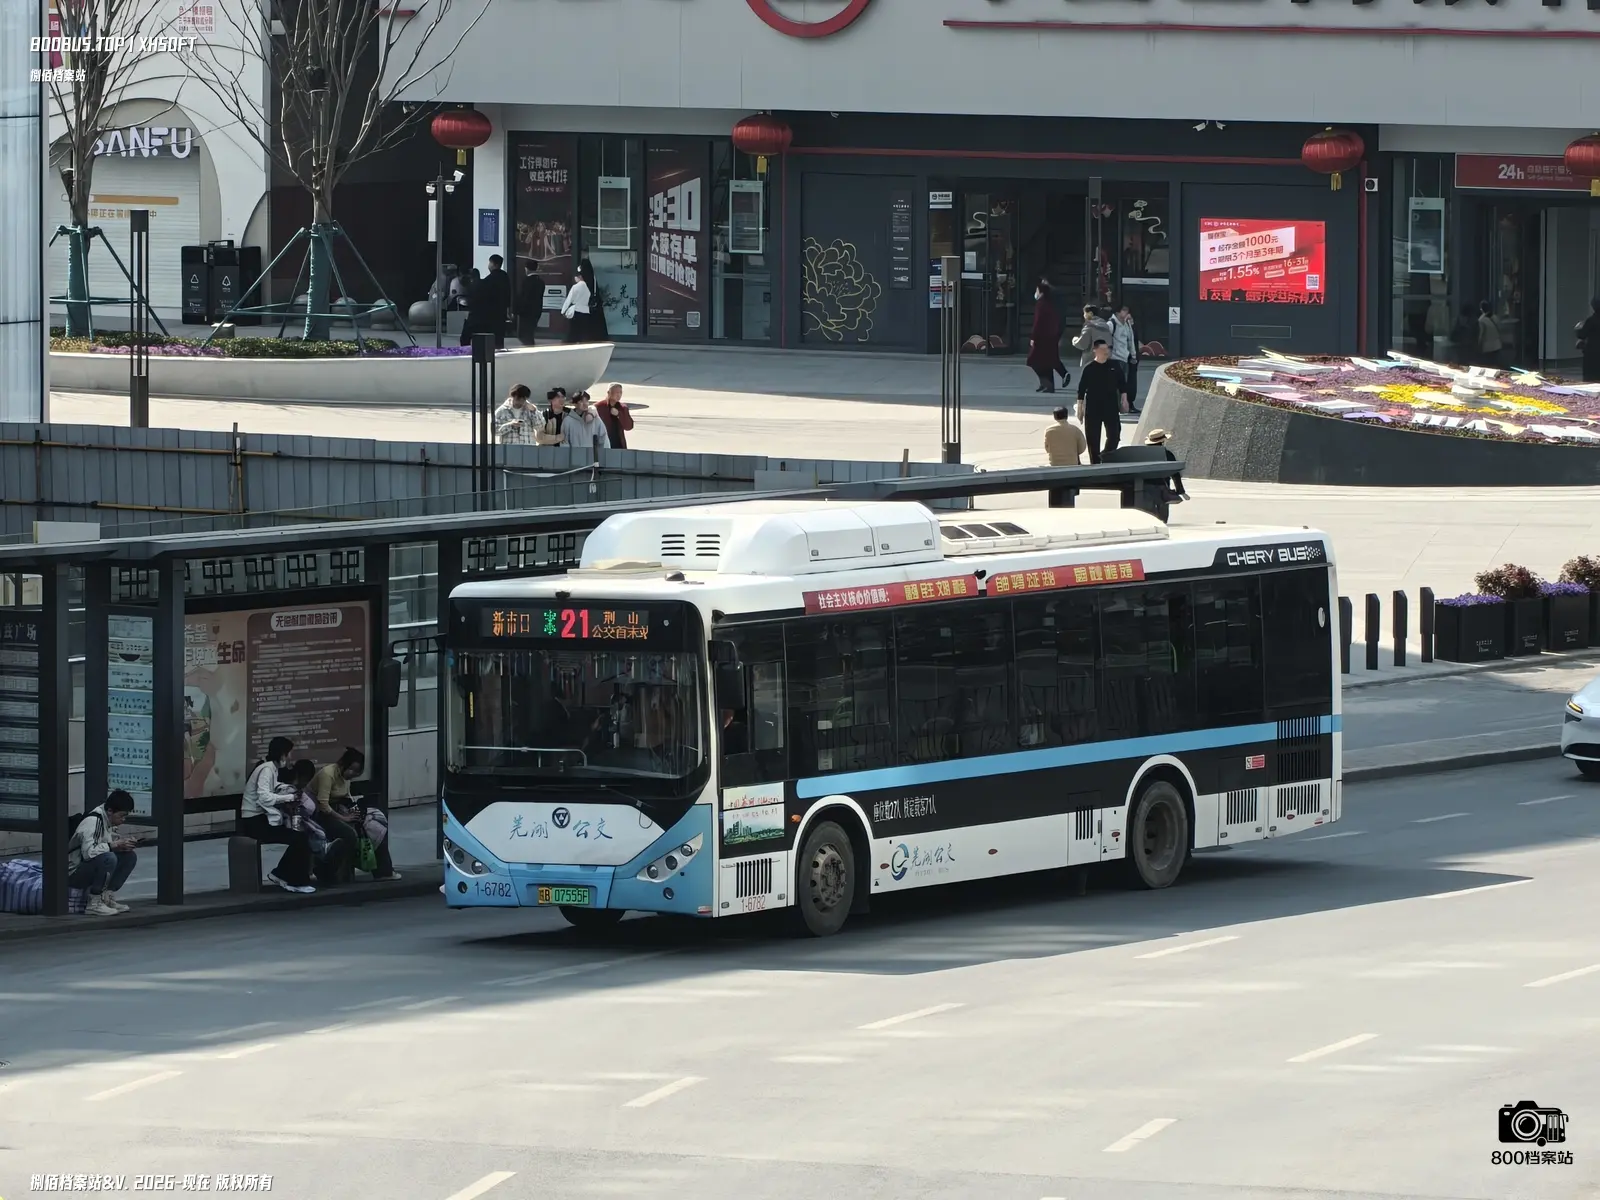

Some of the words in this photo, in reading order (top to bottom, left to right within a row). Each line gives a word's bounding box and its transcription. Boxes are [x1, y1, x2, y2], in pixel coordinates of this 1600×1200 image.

[1497, 164, 1525, 180] 24h
[653, 177, 701, 232] 9:30
[1227, 264, 1260, 280] 1.55%
[1226, 549, 1274, 566] CHERY
[1278, 546, 1307, 562] BUS
[0, 623, 37, 641] 兹广场
[492, 610, 530, 637] 新市口
[561, 609, 589, 639] 21
[474, 881, 512, 898] 1-6782
[741, 895, 766, 912] 1-6782
